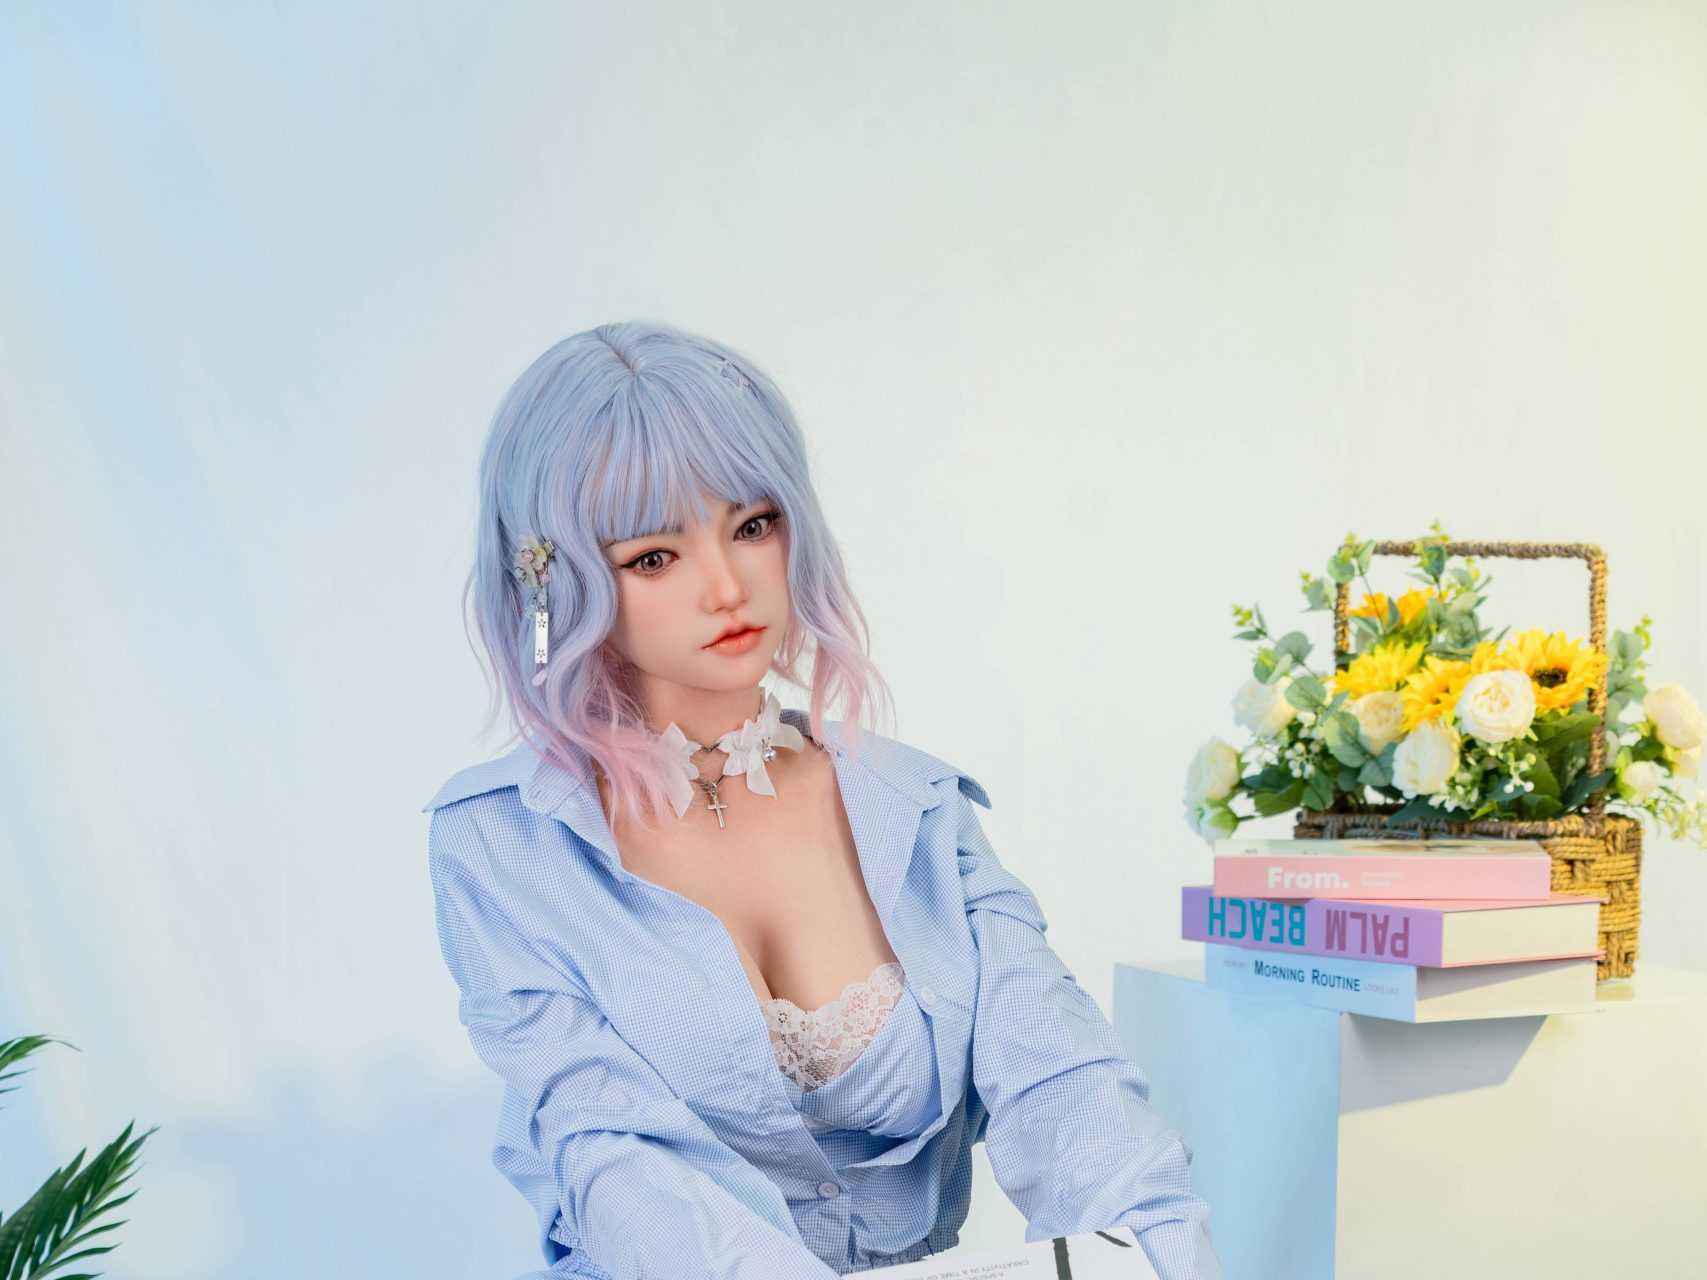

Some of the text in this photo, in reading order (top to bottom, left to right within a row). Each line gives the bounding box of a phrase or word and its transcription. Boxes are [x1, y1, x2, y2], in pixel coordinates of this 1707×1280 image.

[1268, 866, 1350, 889] From.
[1208, 896, 1410, 959] PALM BEACH
[1254, 959, 1305, 983] MORNING
[1312, 969, 1361, 992] ROUTINE
[940, 1271, 961, 1280] TIME
[981, 1259, 1029, 1272] CREATIVITY
